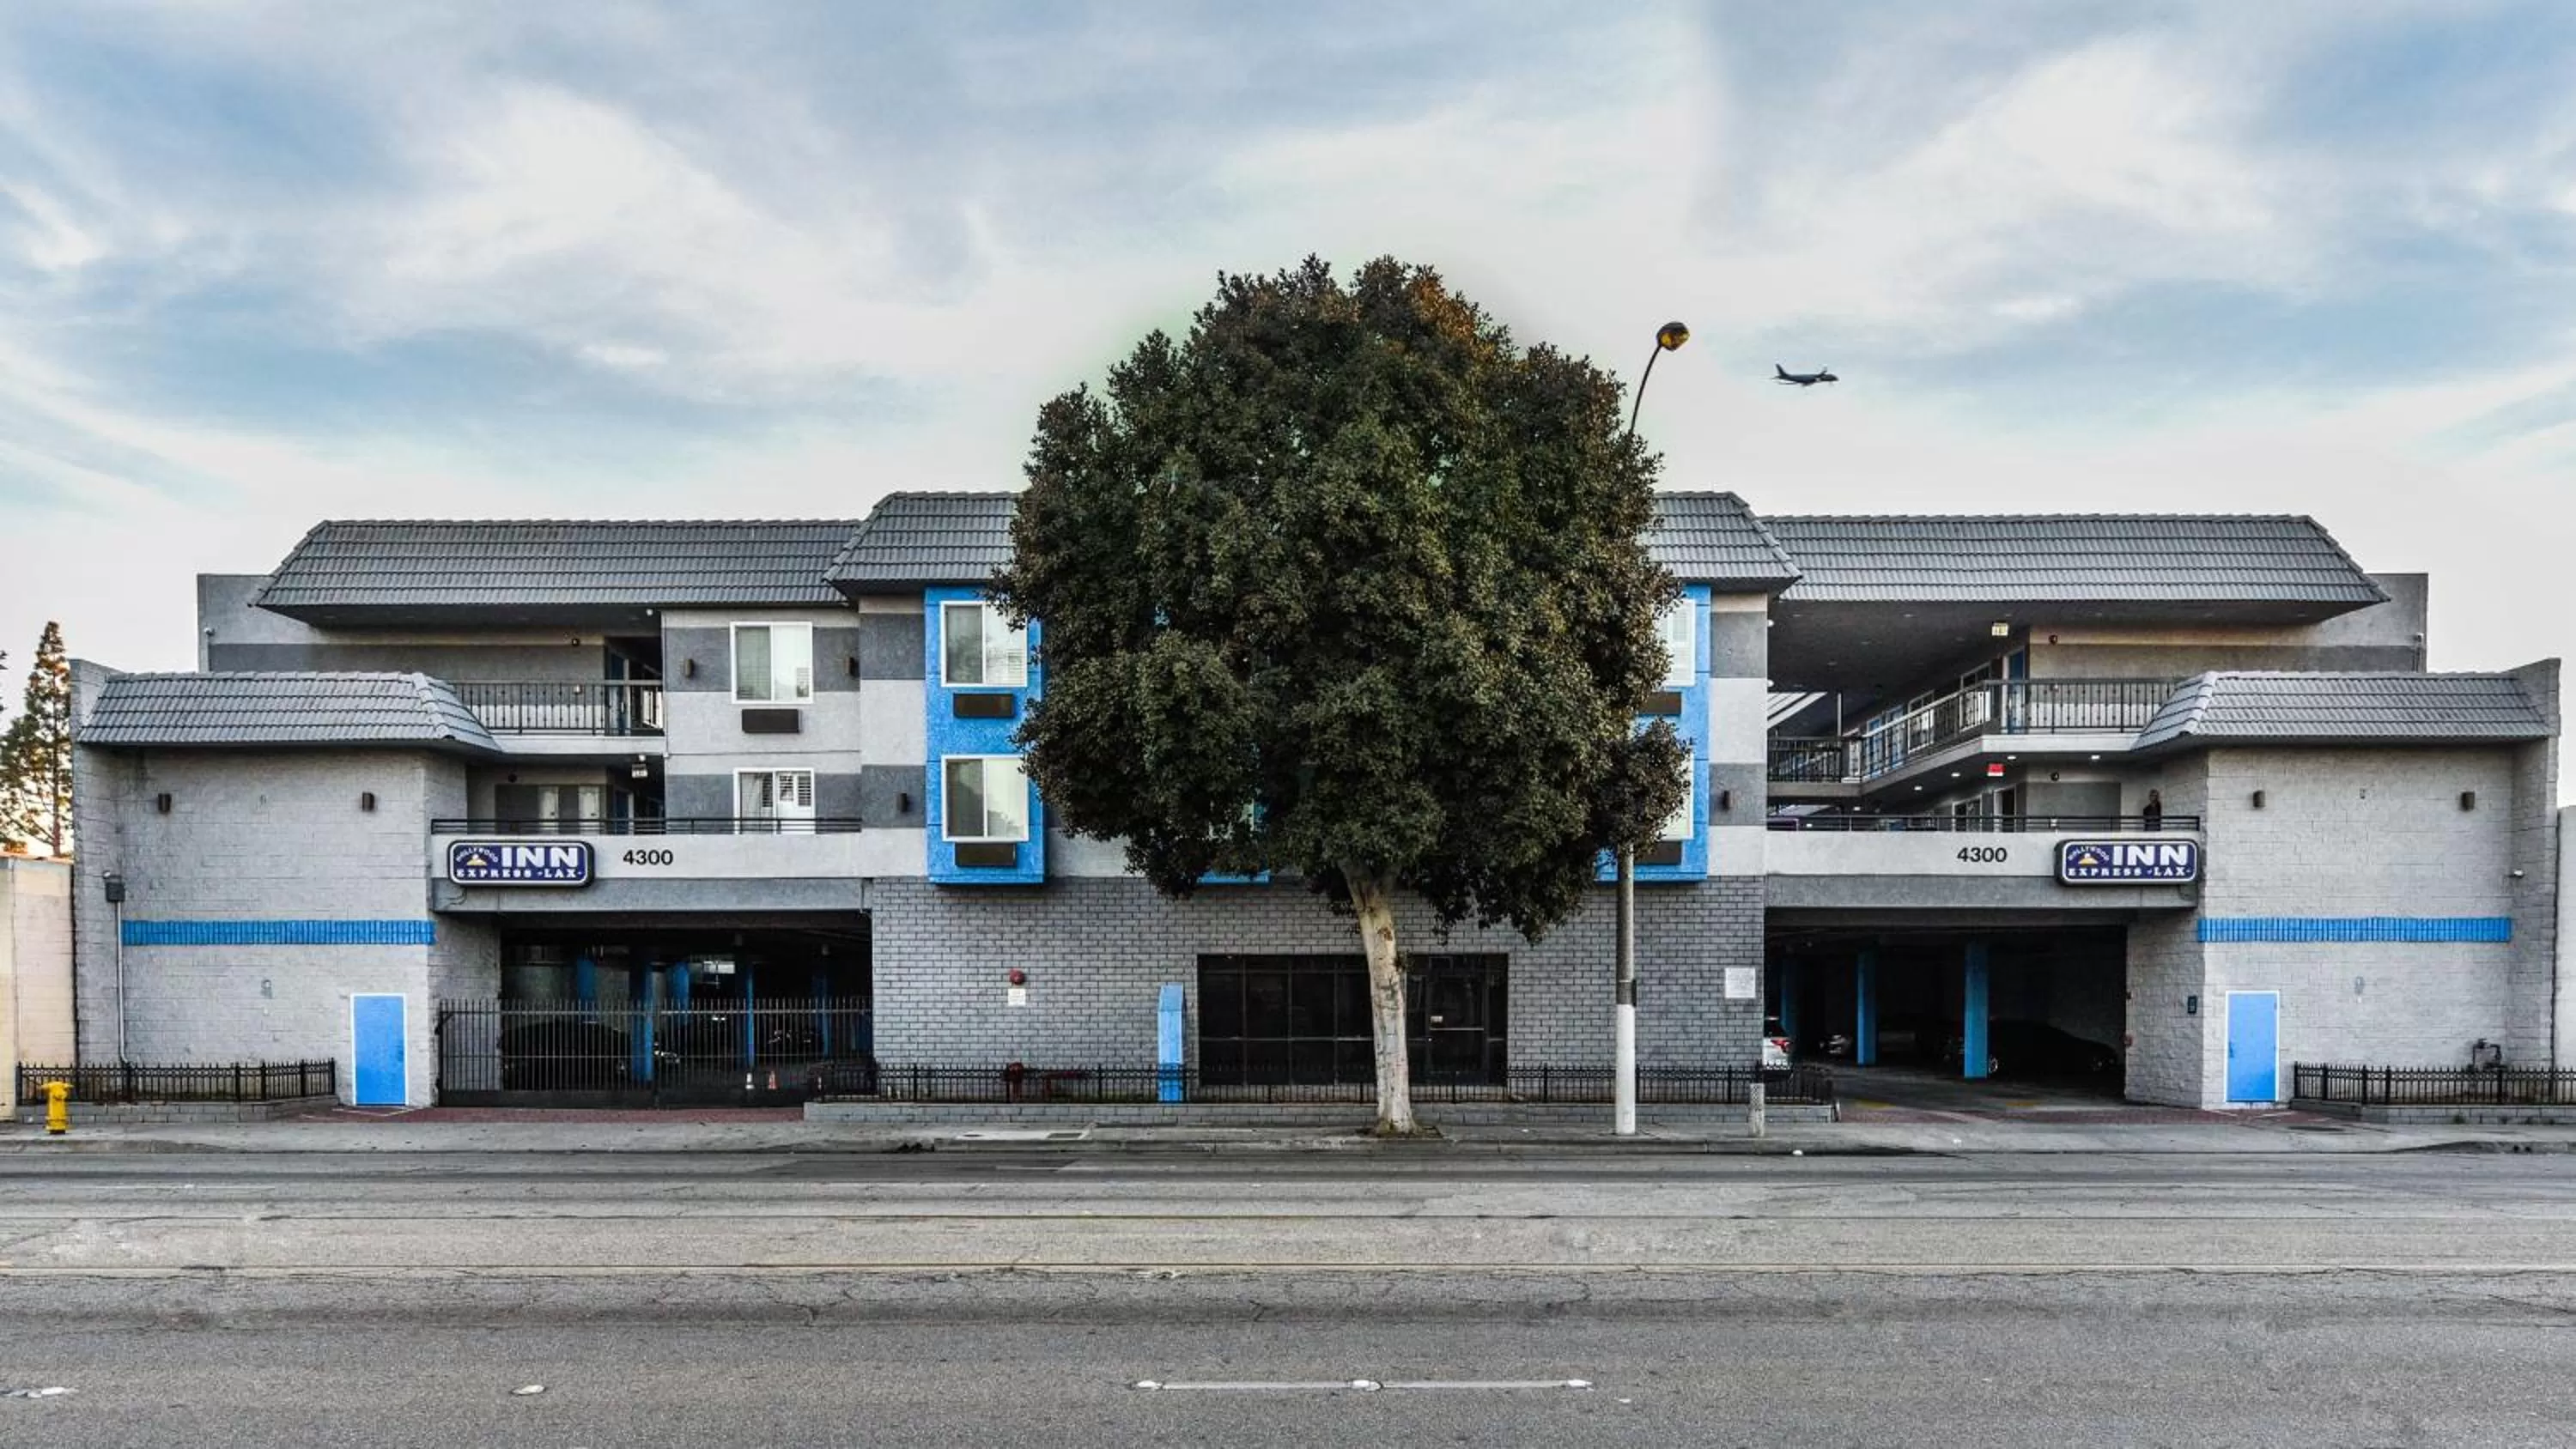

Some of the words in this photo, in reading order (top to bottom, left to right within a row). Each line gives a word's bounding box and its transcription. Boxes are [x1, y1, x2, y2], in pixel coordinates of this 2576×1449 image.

[501, 847, 578, 867] INN
[623, 850, 674, 865] 4300
[1956, 847, 2008, 863] 4300
[2112, 846, 2188, 865] INN
[456, 869, 532, 878] EXPRESS
[2068, 867, 2142, 876] EXPRESS
